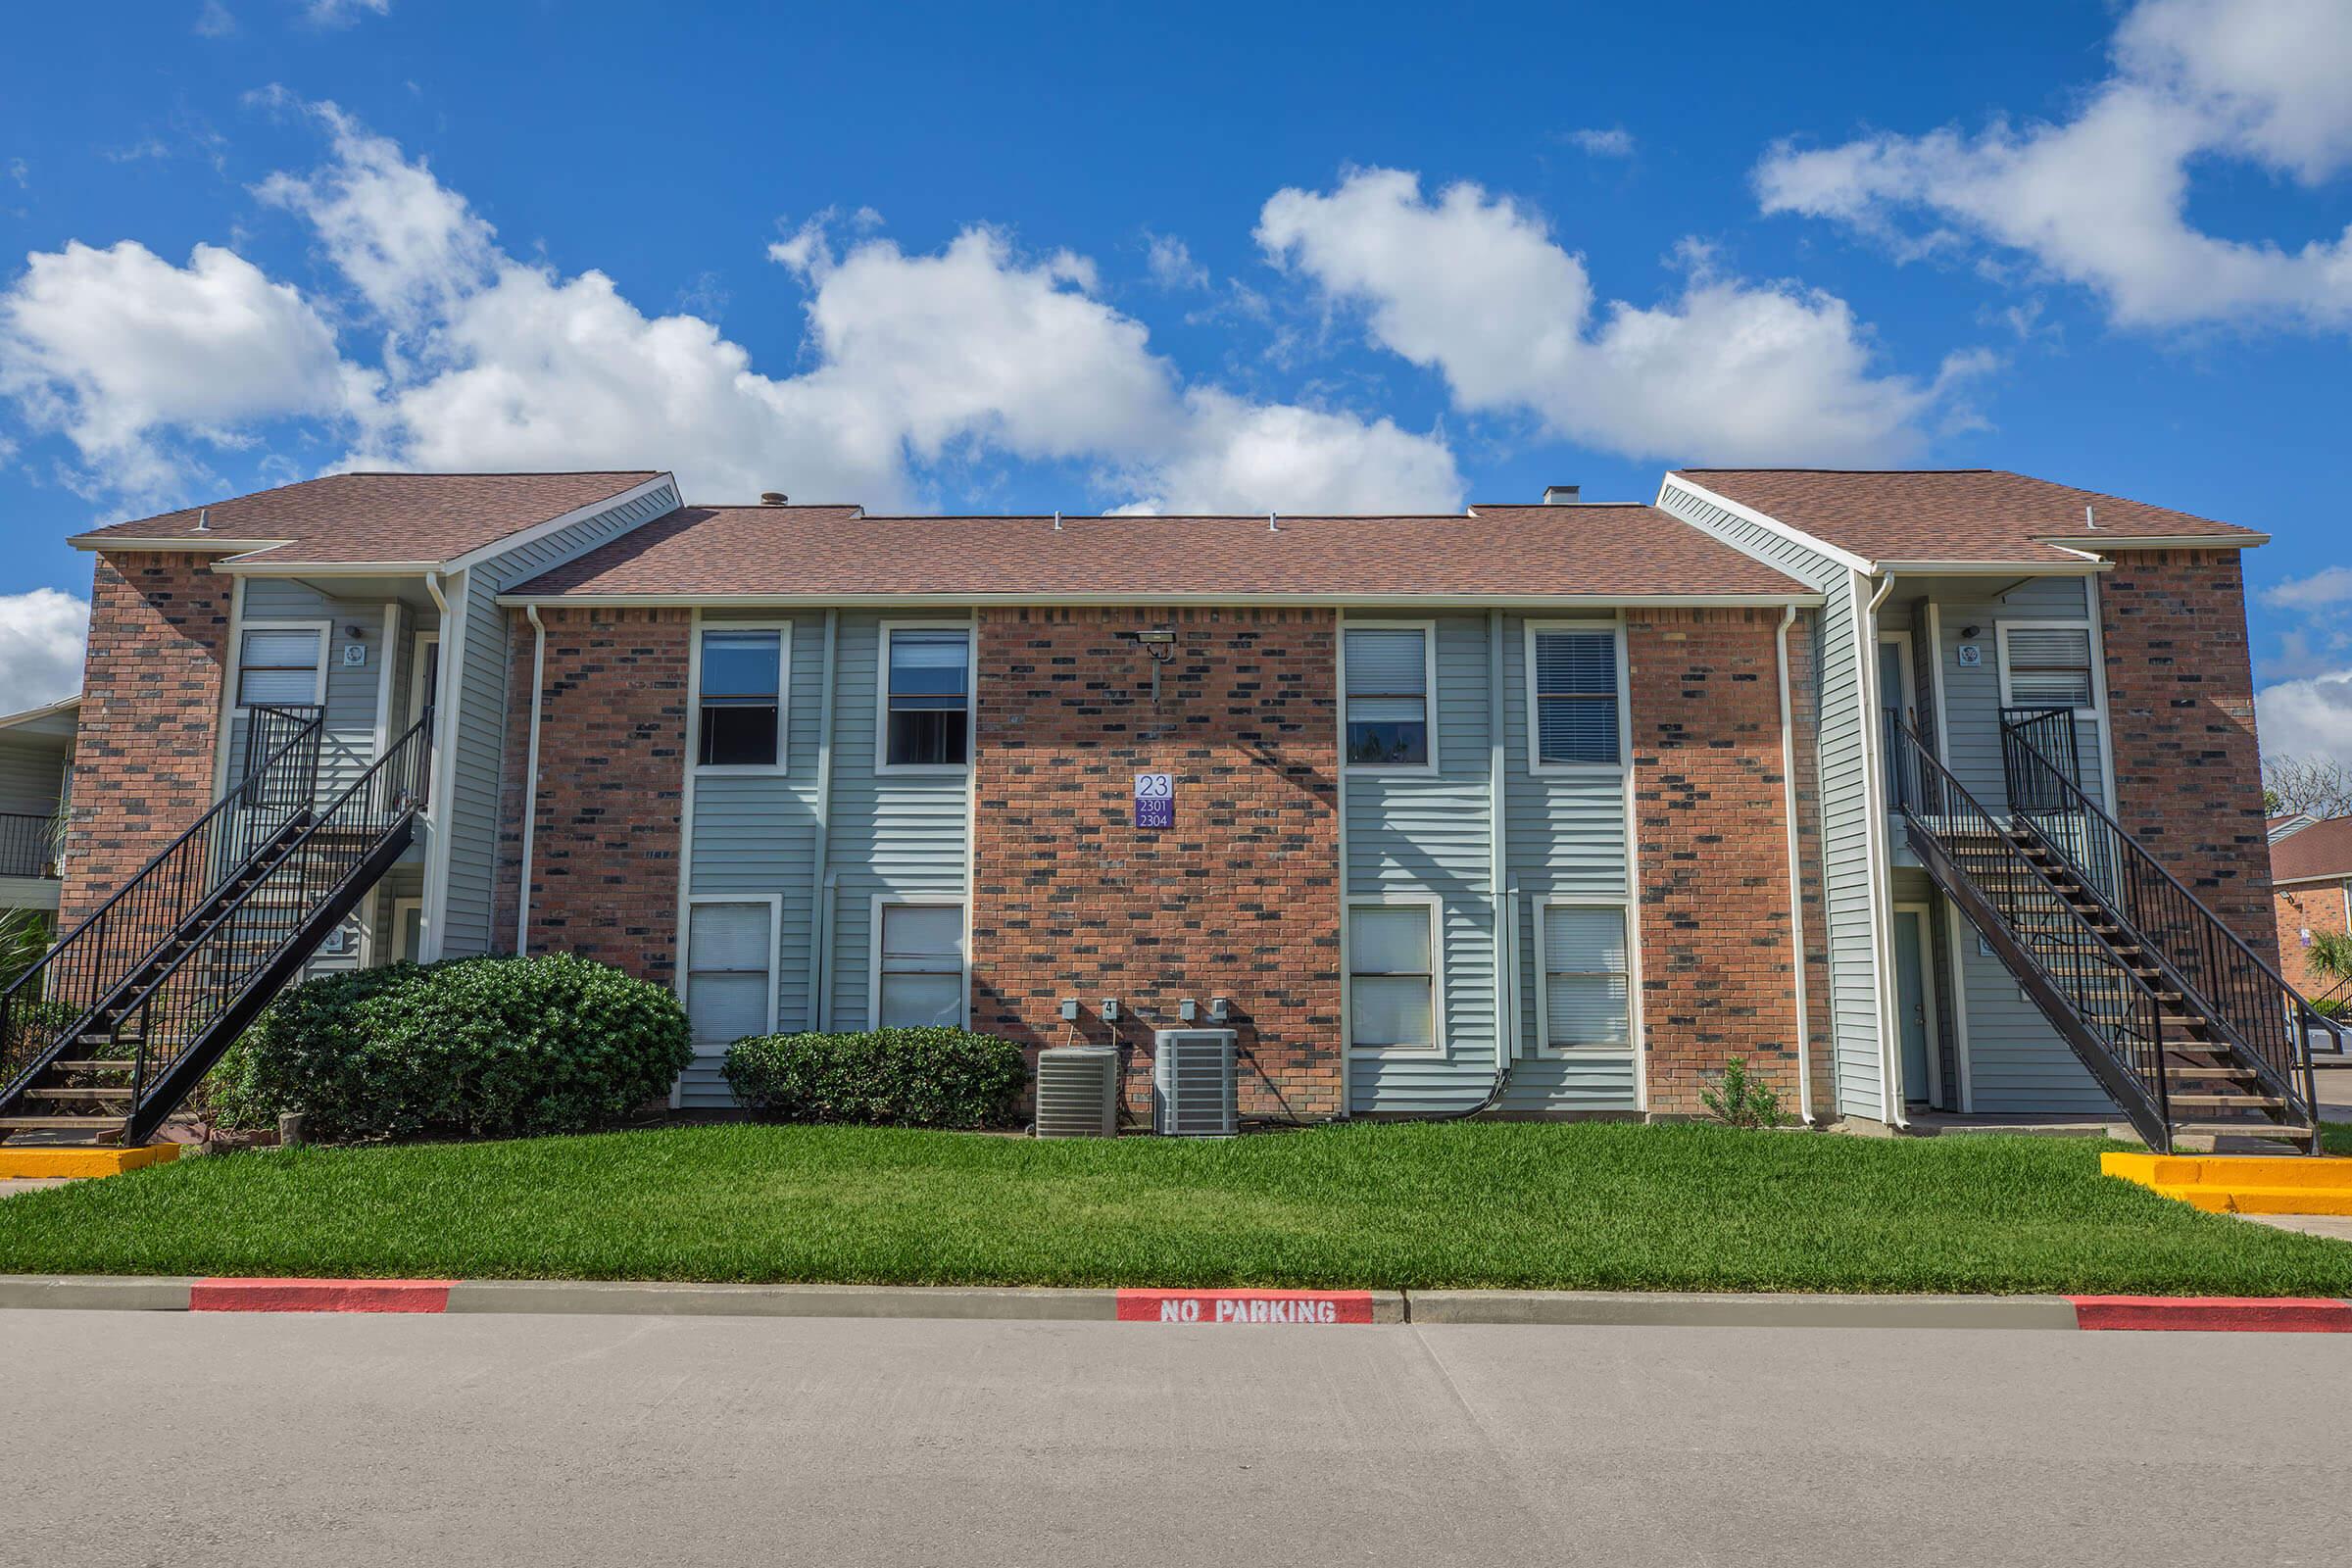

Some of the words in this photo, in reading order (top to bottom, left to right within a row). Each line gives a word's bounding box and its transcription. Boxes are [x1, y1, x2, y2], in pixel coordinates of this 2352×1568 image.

[1140, 775, 1168, 797] 23
[1140, 800, 1166, 811] 2301
[1140, 814, 1168, 827] 2304
[1105, 1002, 1112, 1013] 4
[1160, 1299, 1200, 1322] NO
[1215, 1299, 1338, 1322] PARKING
